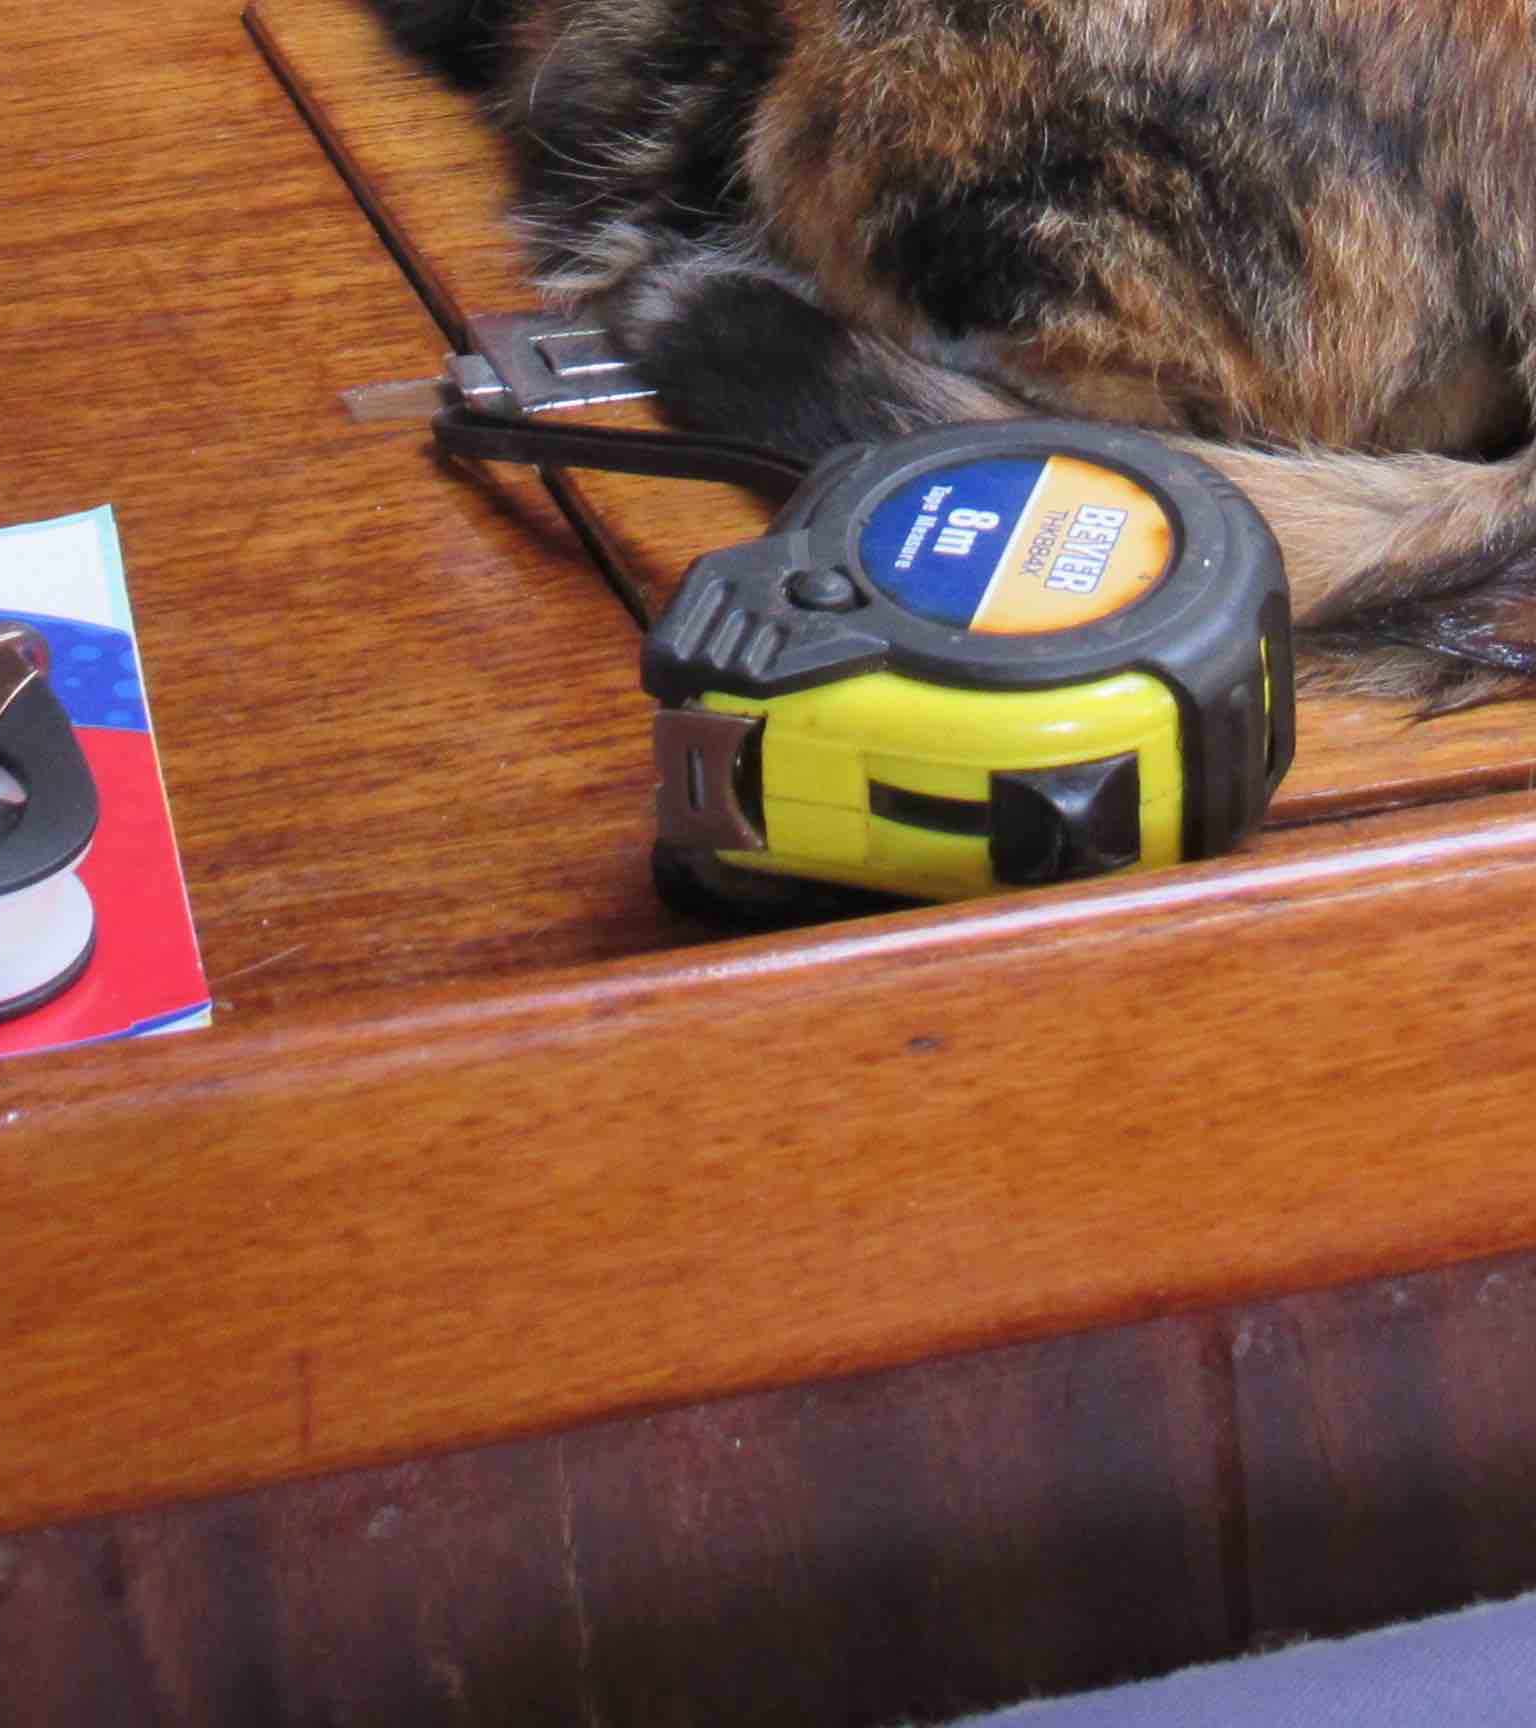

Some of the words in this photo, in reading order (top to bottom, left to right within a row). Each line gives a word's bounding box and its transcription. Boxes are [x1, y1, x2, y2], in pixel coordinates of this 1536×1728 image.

[921, 484, 953, 513] Tape
[893, 513, 938, 569] Measure
[932, 507, 1001, 557] 8m
[1045, 503, 1129, 594] BEYER
